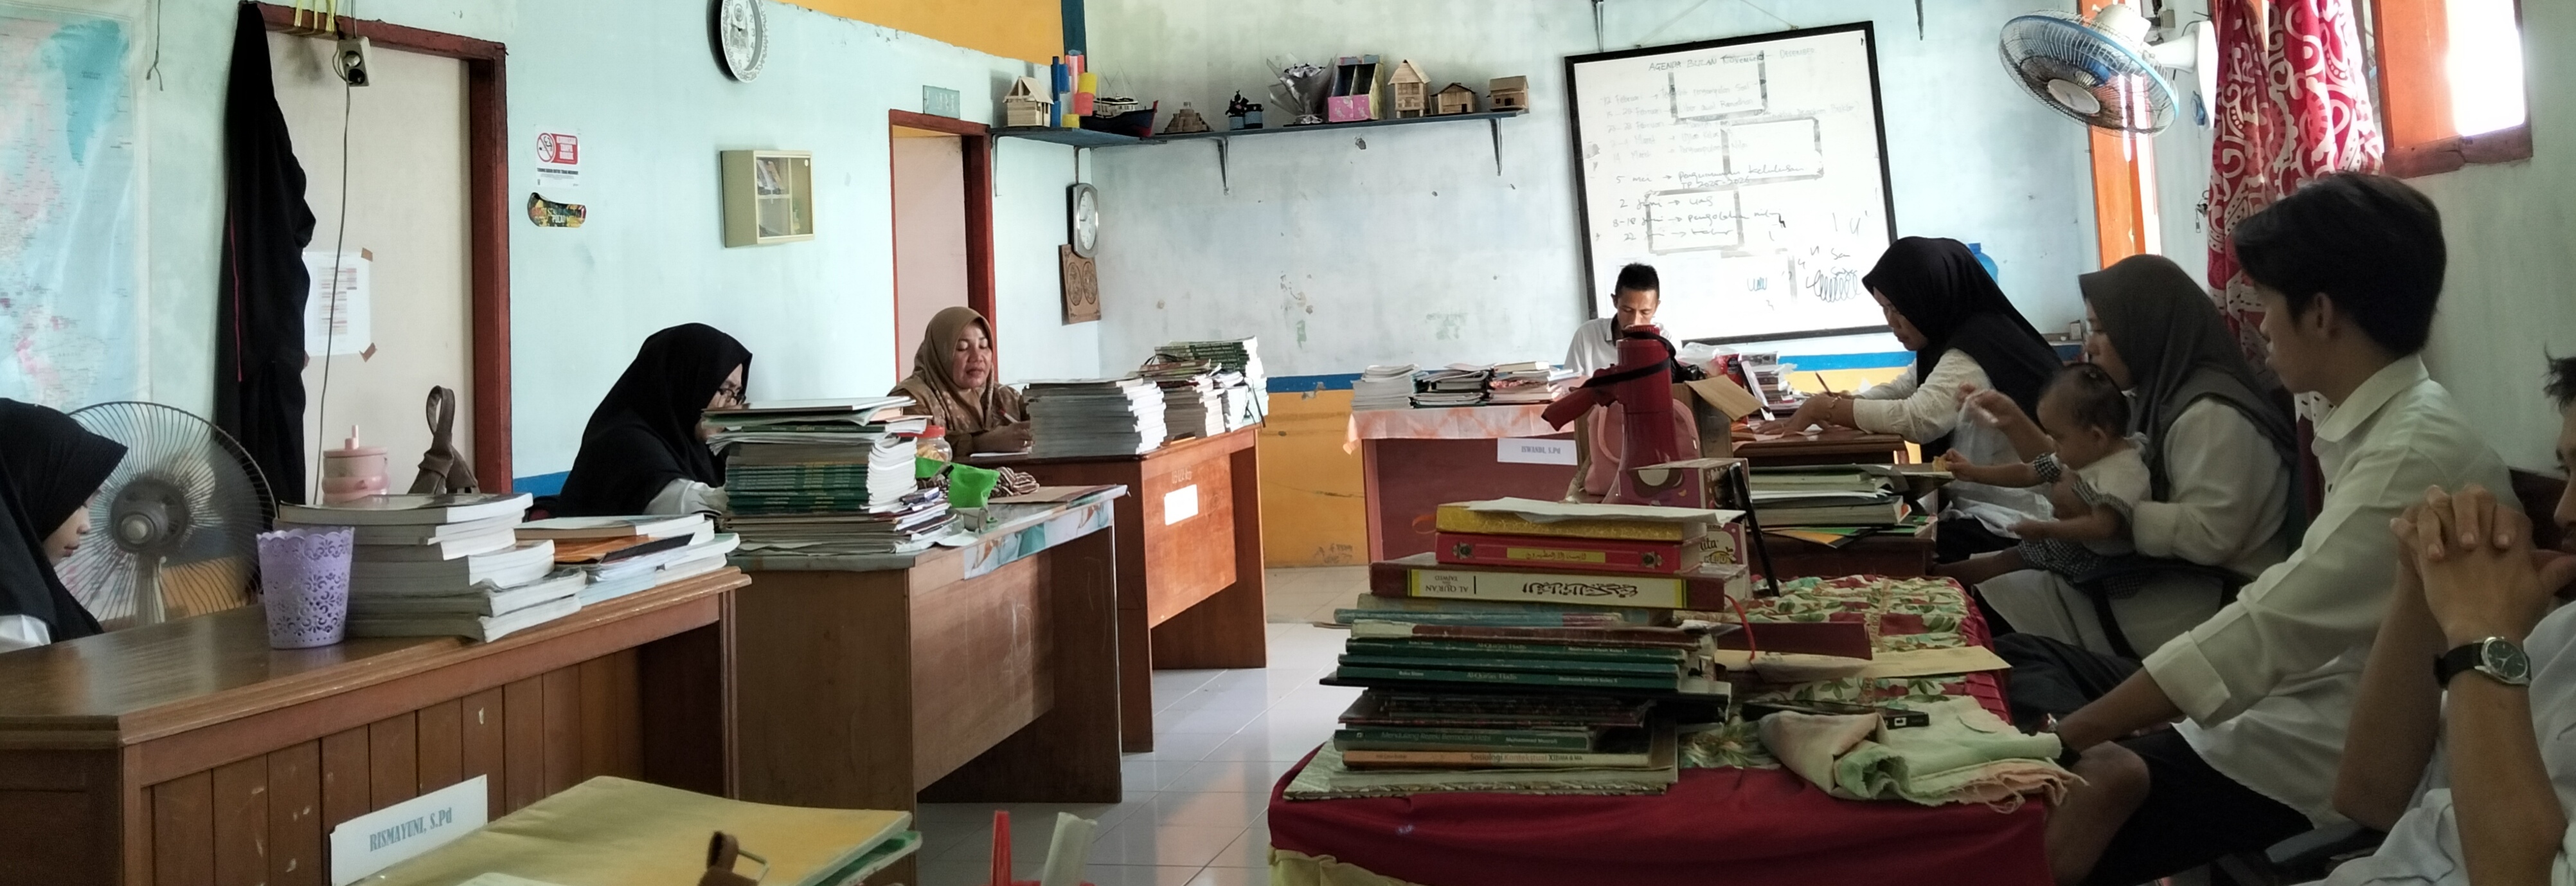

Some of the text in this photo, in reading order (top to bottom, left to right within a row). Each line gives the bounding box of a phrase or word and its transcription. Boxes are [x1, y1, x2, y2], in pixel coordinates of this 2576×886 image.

[1649, 61, 1681, 71] AGENDA
[1687, 57, 1717, 68] BULAN
[1470, 753, 1503, 763] Sosiologi
[369, 806, 452, 853] RISMAYUNI, S.Pd
